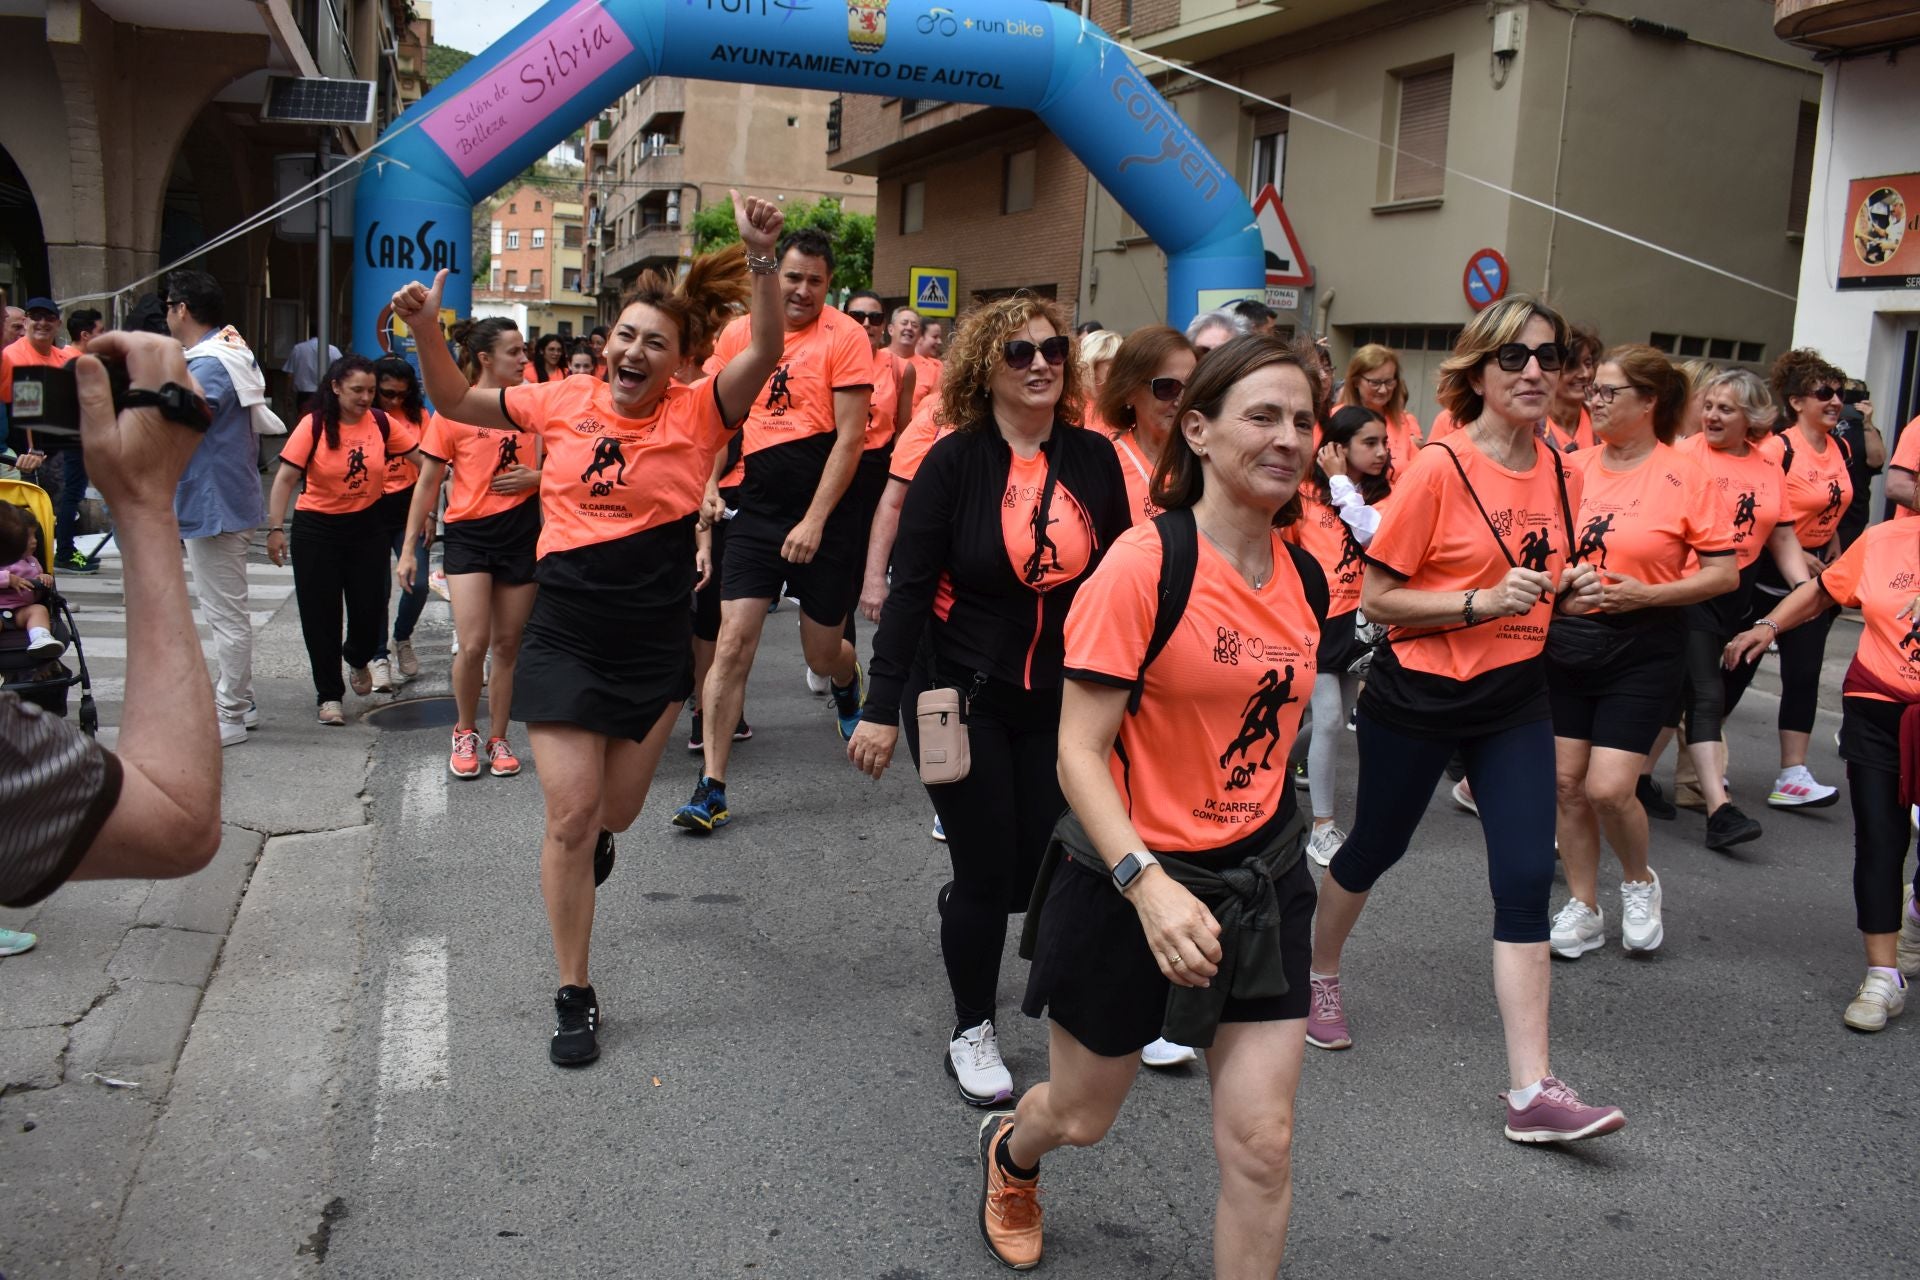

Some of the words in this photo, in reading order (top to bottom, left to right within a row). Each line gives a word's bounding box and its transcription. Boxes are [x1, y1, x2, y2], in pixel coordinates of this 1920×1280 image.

[519, 22, 614, 104] Silvia
[710, 44, 892, 79] AYUNTAMIENTO
[896, 63, 927, 83] DE
[931, 66, 1006, 91] AUTOL
[453, 98, 495, 131] Salón
[494, 81, 510, 102] de
[456, 116, 508, 157] Belleza
[575, 510, 598, 519] CONTRA
[580, 503, 588, 511] IX
[588, 503, 627, 512] CARRERA
[1503, 624, 1545, 634] CARRERA
[1204, 798, 1216, 810] IX
[1192, 809, 1229, 824] CONTRA
[1230, 814, 1242, 824] EL
